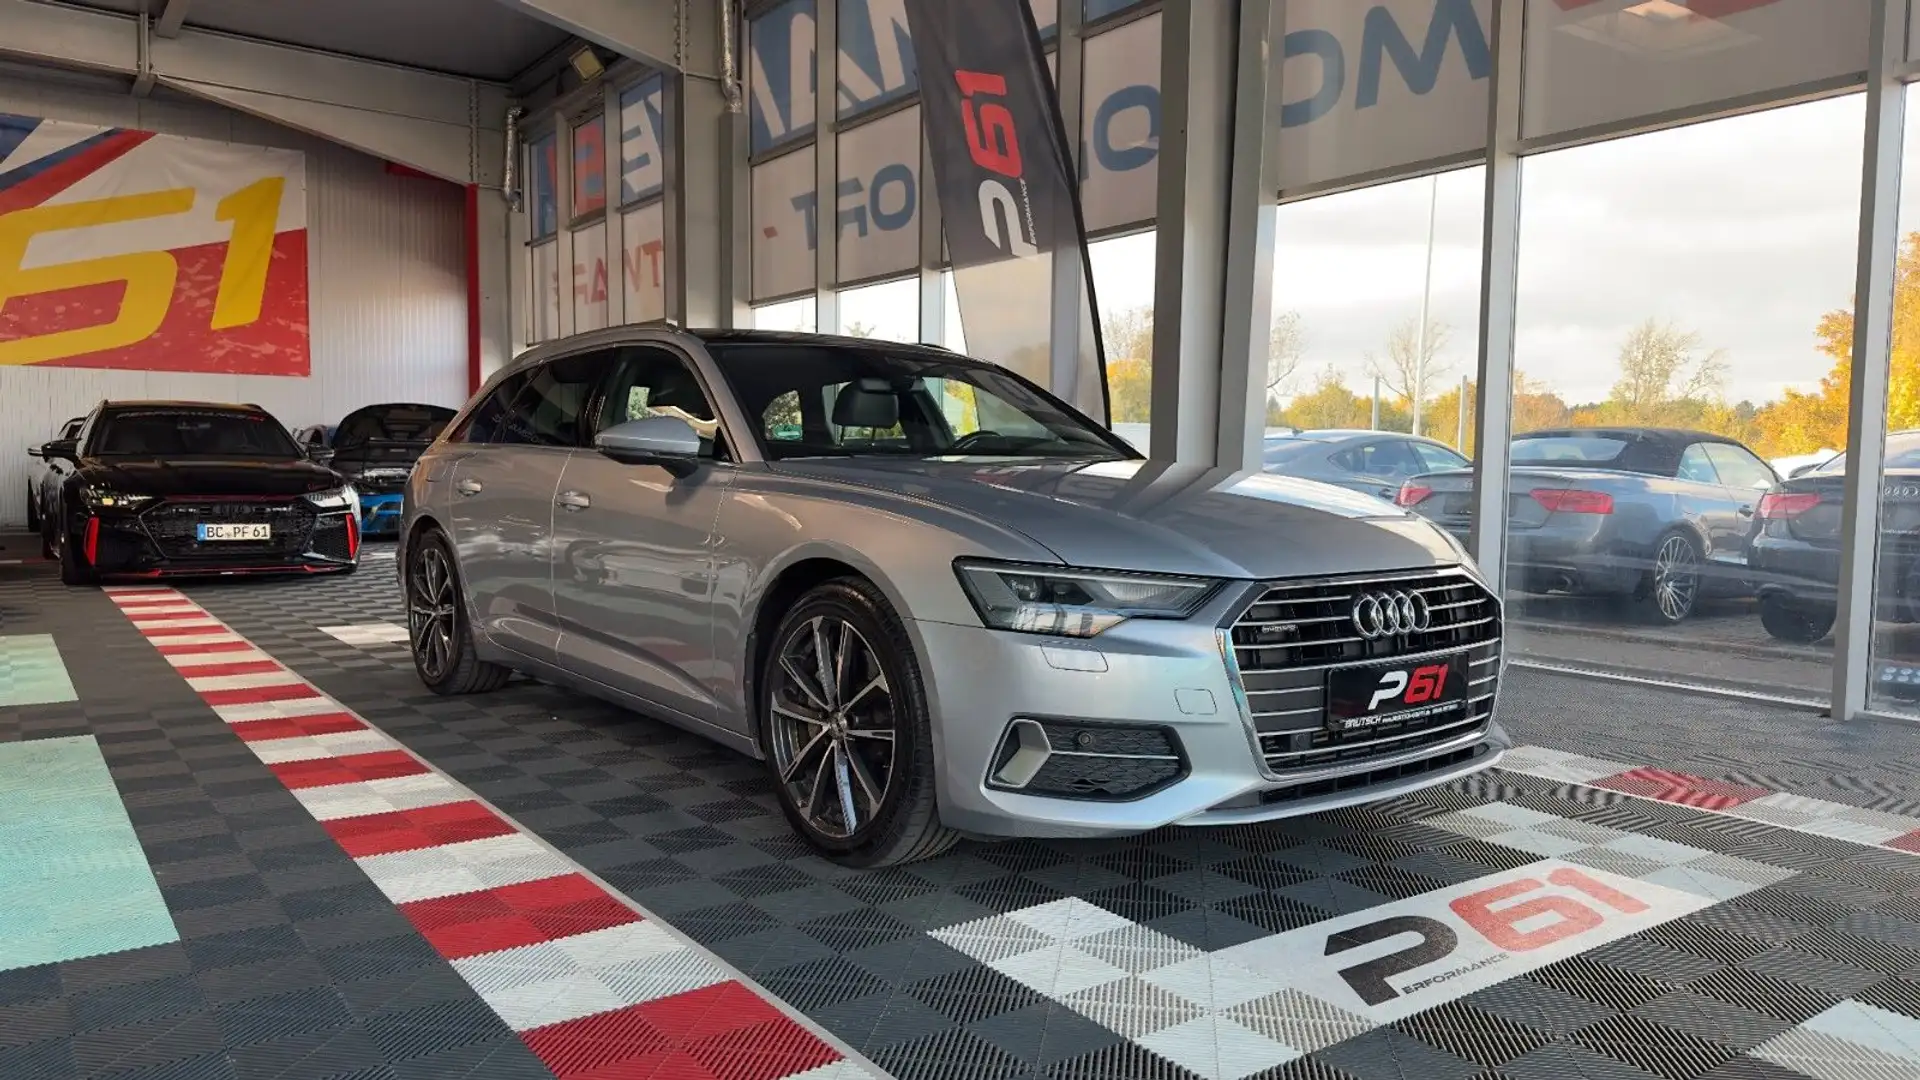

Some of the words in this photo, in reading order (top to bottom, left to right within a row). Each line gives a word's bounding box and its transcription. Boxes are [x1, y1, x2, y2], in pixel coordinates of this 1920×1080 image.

[953, 69, 1039, 258] P61
[206, 526, 224, 538] BC
[232, 526, 249, 538] PF
[252, 525, 268, 538] 61
[1367, 663, 1449, 711] P61
[1324, 867, 1652, 1006] P61
